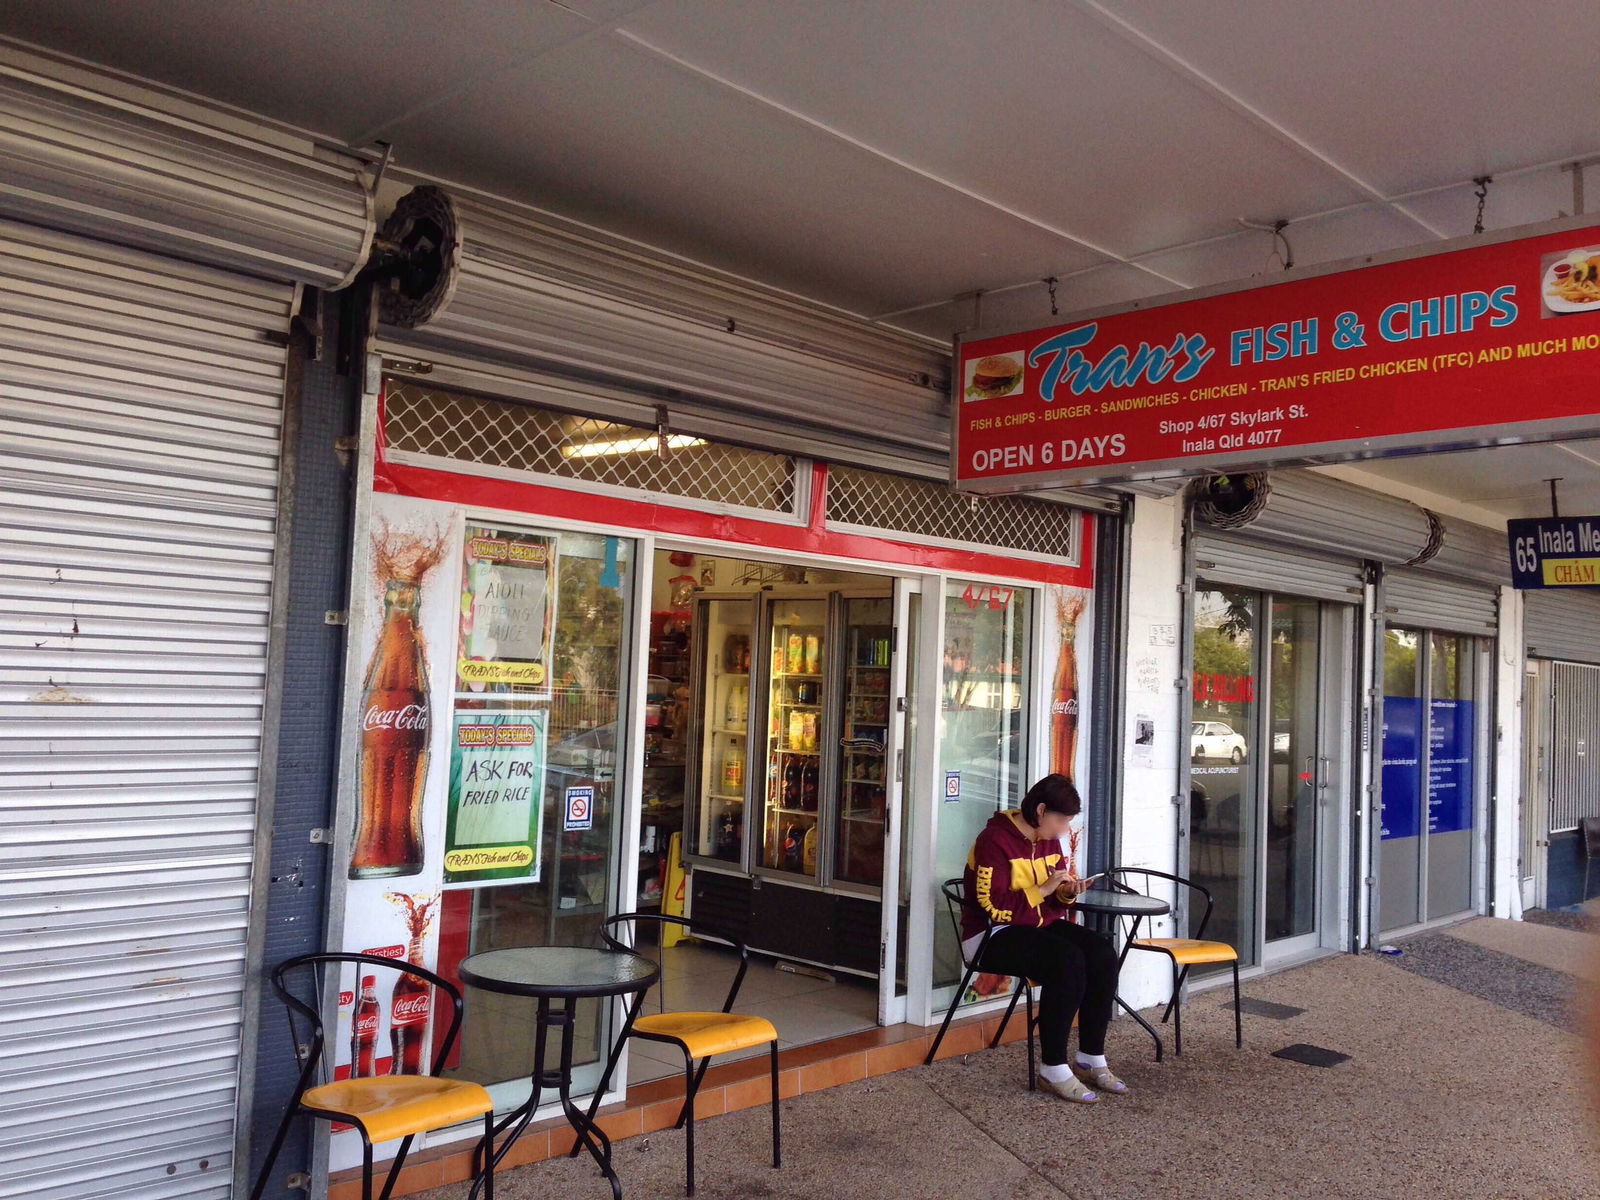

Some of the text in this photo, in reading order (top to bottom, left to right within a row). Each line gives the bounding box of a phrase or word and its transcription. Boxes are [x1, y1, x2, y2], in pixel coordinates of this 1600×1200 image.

[1028, 285, 1519, 402] Tran's FISH & CHIPS
[970, 416, 992, 431] FISH
[995, 416, 1003, 428] &
[1004, 411, 1036, 427] CHIPS
[1044, 404, 1091, 422] BURGER
[1101, 391, 1179, 414] SANDWICHES
[1190, 382, 1248, 402] CHICKEN
[1259, 374, 1309, 393] TRAN'S
[1313, 367, 1356, 386] FRIED
[1359, 356, 1428, 379] CHICKEN
[1432, 351, 1474, 373] (TFC)
[1478, 346, 1512, 365] AND
[1517, 337, 1567, 359] MUCH
[1159, 404, 1309, 437] Shop 4/67 Skylark St.
[972, 433, 1126, 471] OPEN 6 DAYS
[1182, 429, 1282, 453] Inala Qld 4077
[1538, 522, 1600, 553] Inala Me
[473, 540, 546, 563] TODAY'S SPECIALS
[1516, 536, 1537, 573] 65
[962, 583, 1014, 611] 4/67
[363, 704, 428, 731] Coca-Cola
[1052, 698, 1078, 715] Coca-Cola
[459, 726, 534, 745] TODAY'S SPECIALS
[466, 760, 533, 782] ASK FOR
[463, 787, 530, 808] FRIED RICE
[497, 852, 510, 862] and
[510, 850, 529, 864] Chips
[394, 995, 429, 1017] Coca-Cola
